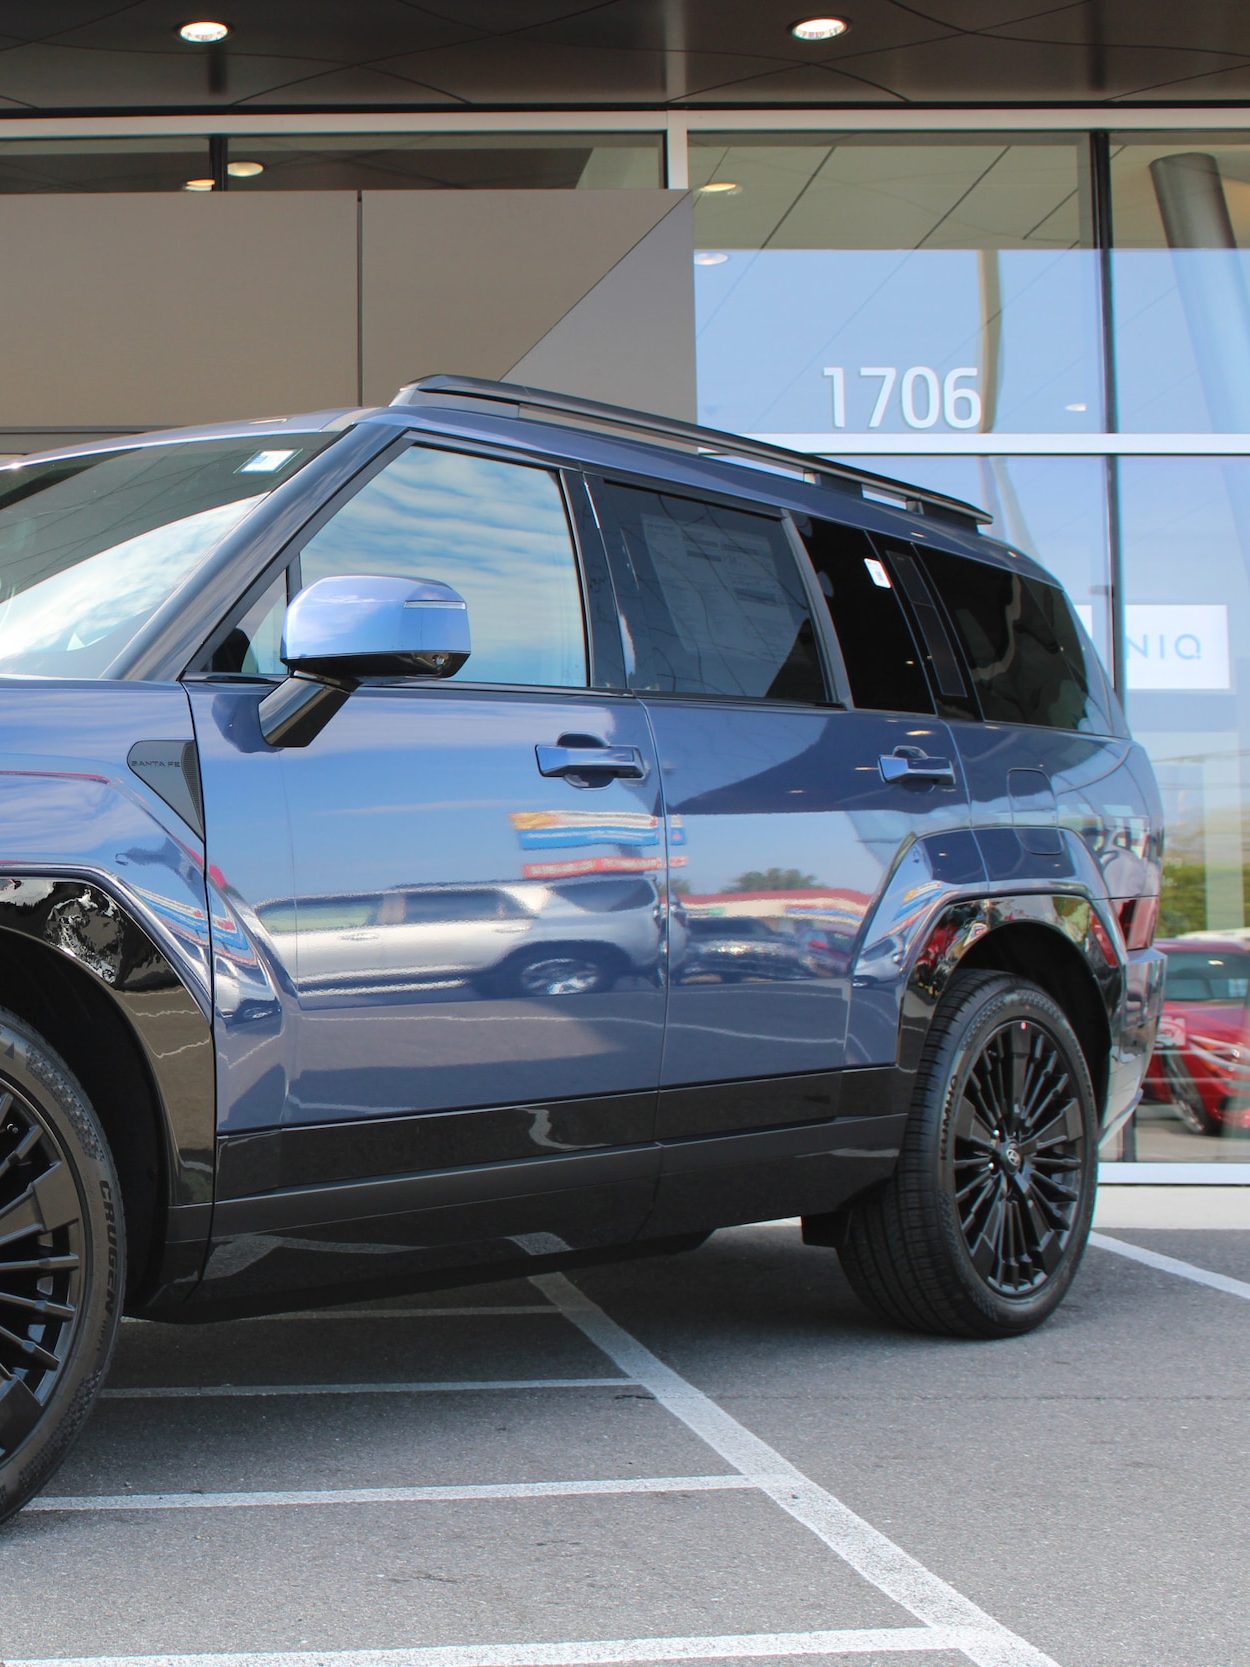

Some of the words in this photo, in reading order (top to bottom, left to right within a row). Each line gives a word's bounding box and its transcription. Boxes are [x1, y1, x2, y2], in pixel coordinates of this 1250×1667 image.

[822, 366, 982, 429] 1706
[939, 1074, 957, 1161] KUMHO
[100, 1180, 118, 1316] CRUGEN
